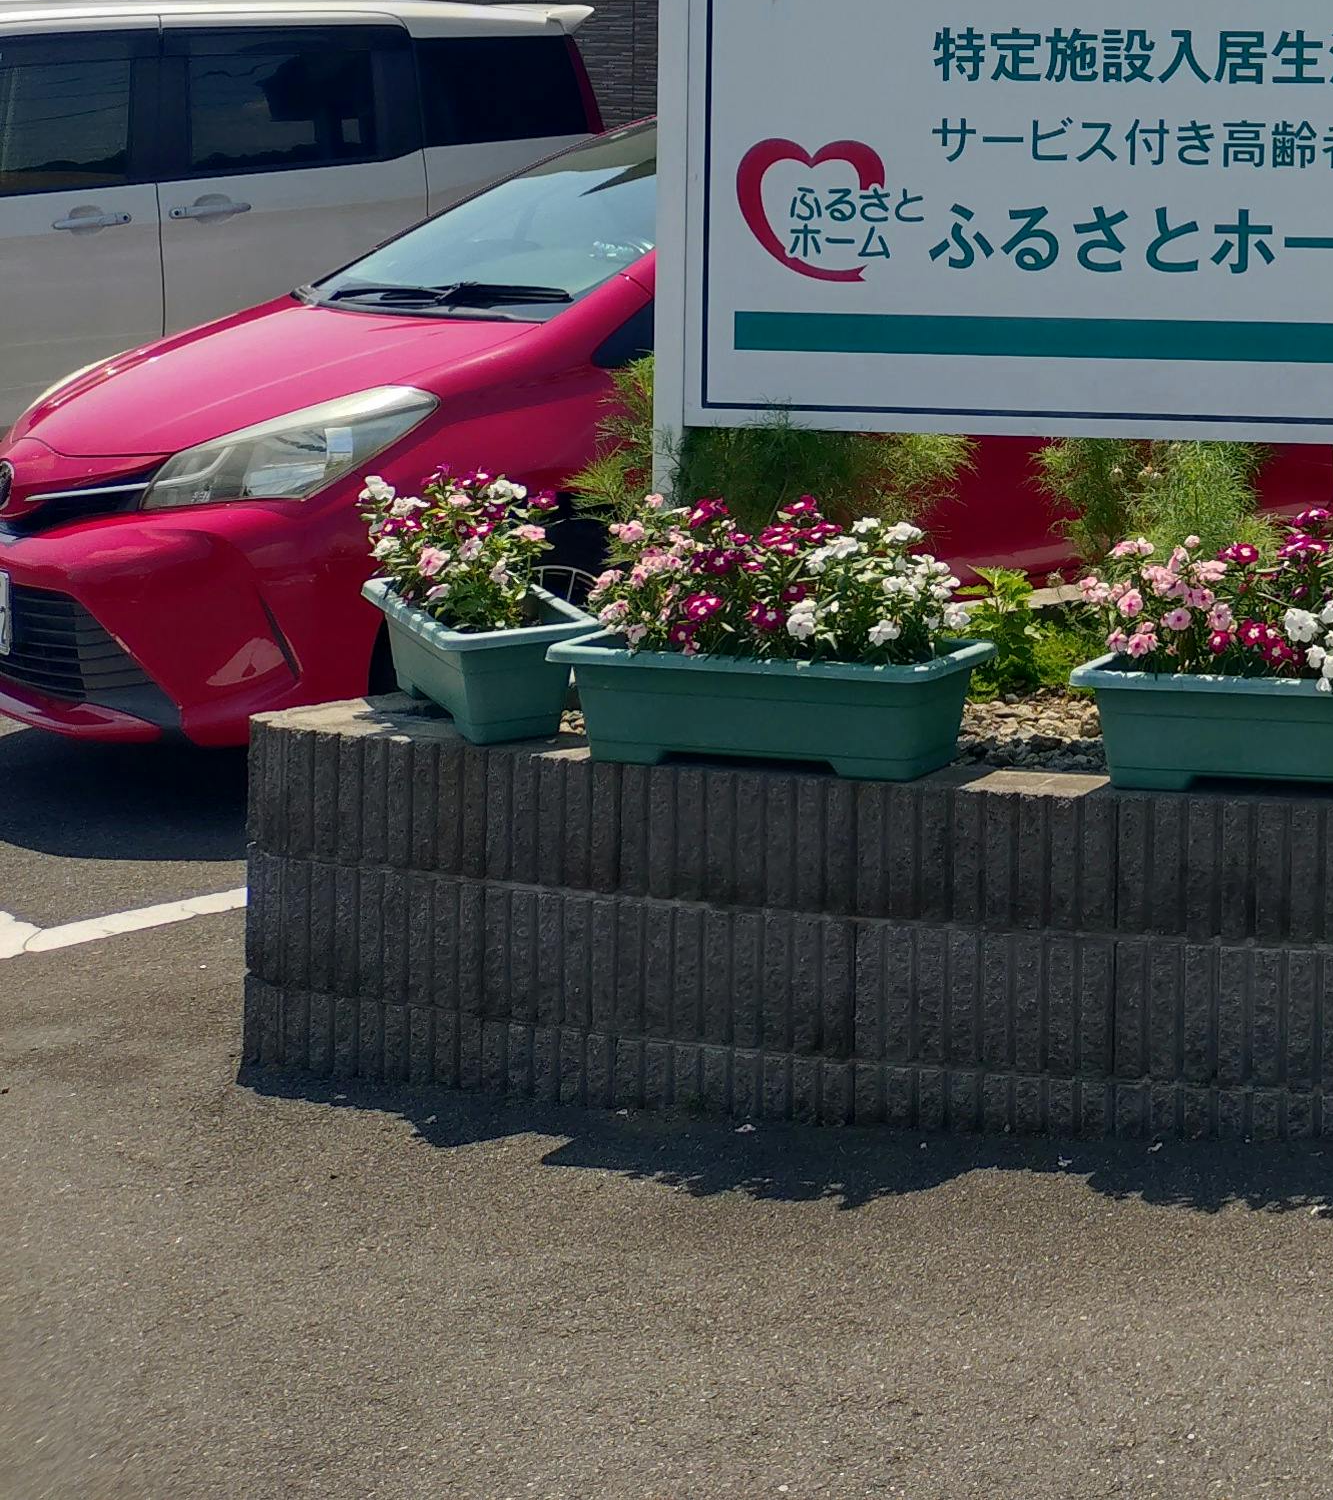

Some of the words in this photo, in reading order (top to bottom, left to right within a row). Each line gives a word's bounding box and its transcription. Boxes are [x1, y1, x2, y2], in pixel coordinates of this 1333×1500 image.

[789, 186, 925, 223] ふるさと
[789, 223, 891, 258] ホーム
